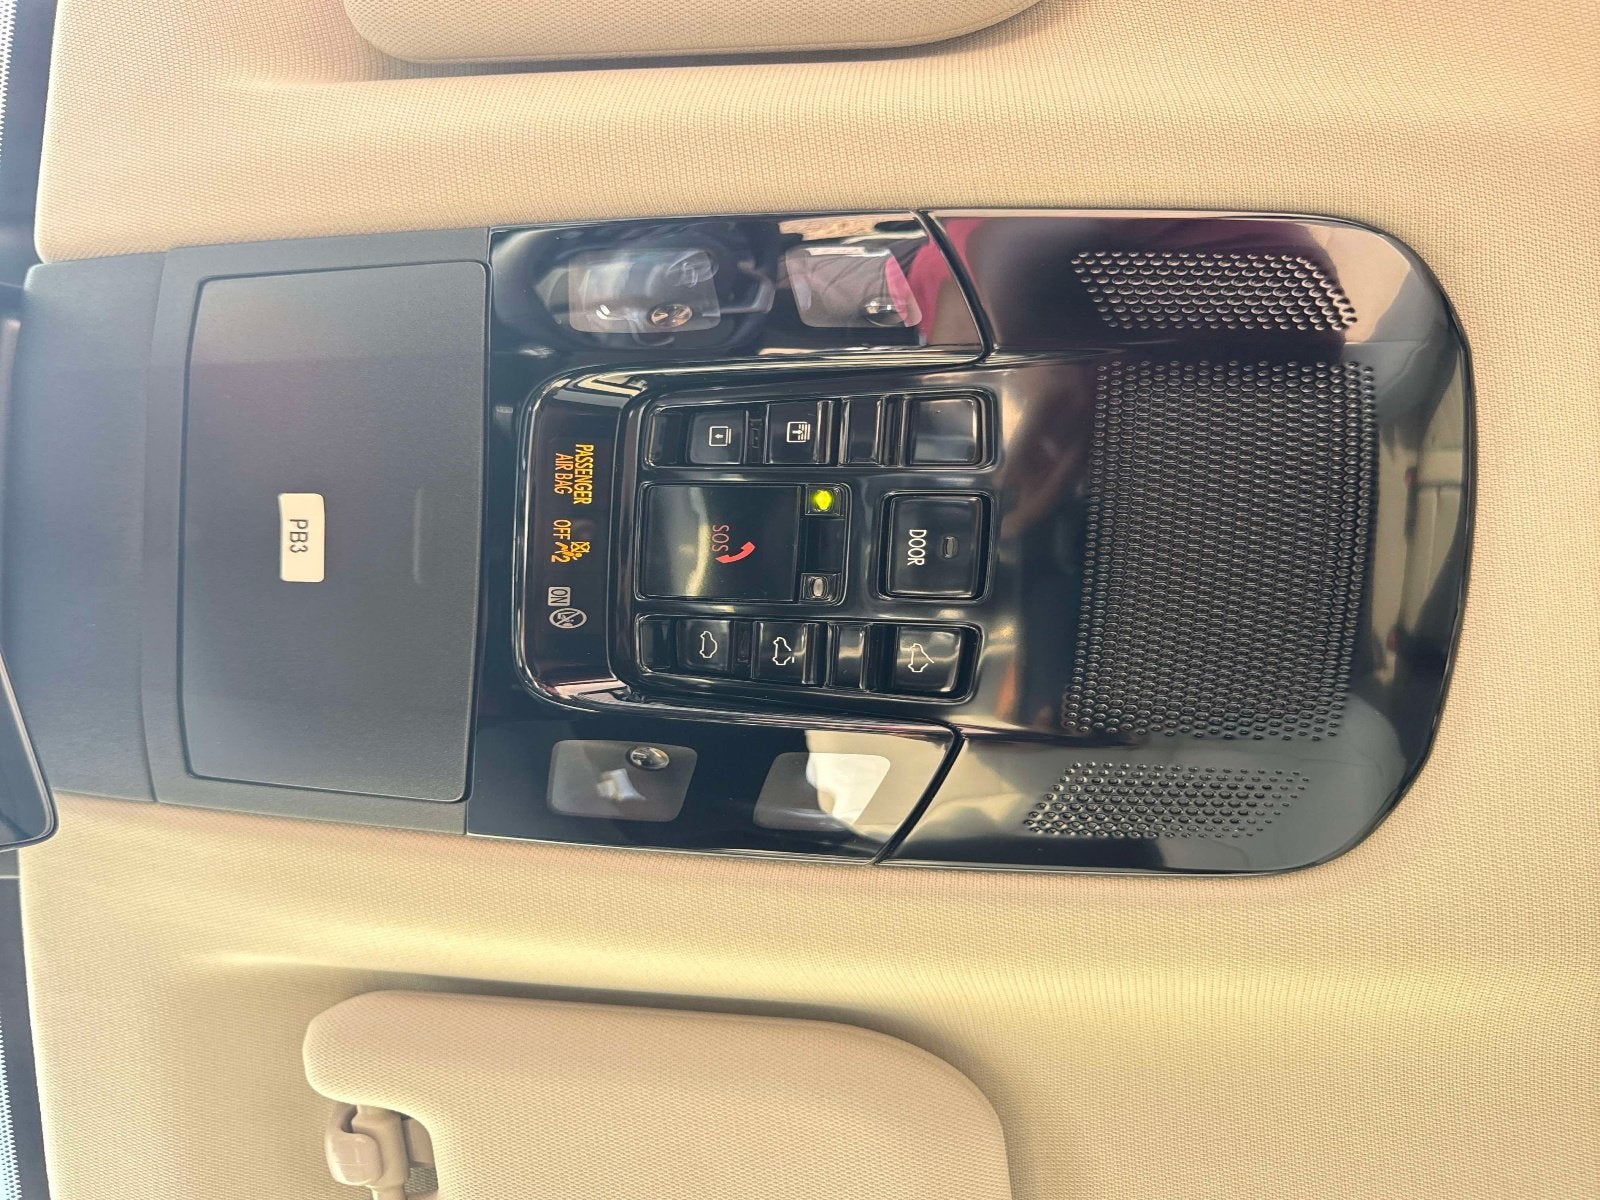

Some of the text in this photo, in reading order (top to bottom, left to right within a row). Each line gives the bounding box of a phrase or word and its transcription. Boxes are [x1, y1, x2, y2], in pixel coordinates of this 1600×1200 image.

[553, 452, 574, 495] AIR BAG
[573, 443, 595, 505] PASSENGER
[289, 519, 309, 554] PB3
[553, 519, 572, 540] OFF
[711, 524, 730, 552] SOS
[906, 529, 928, 567] DOOR
[550, 588, 568, 605] ON
